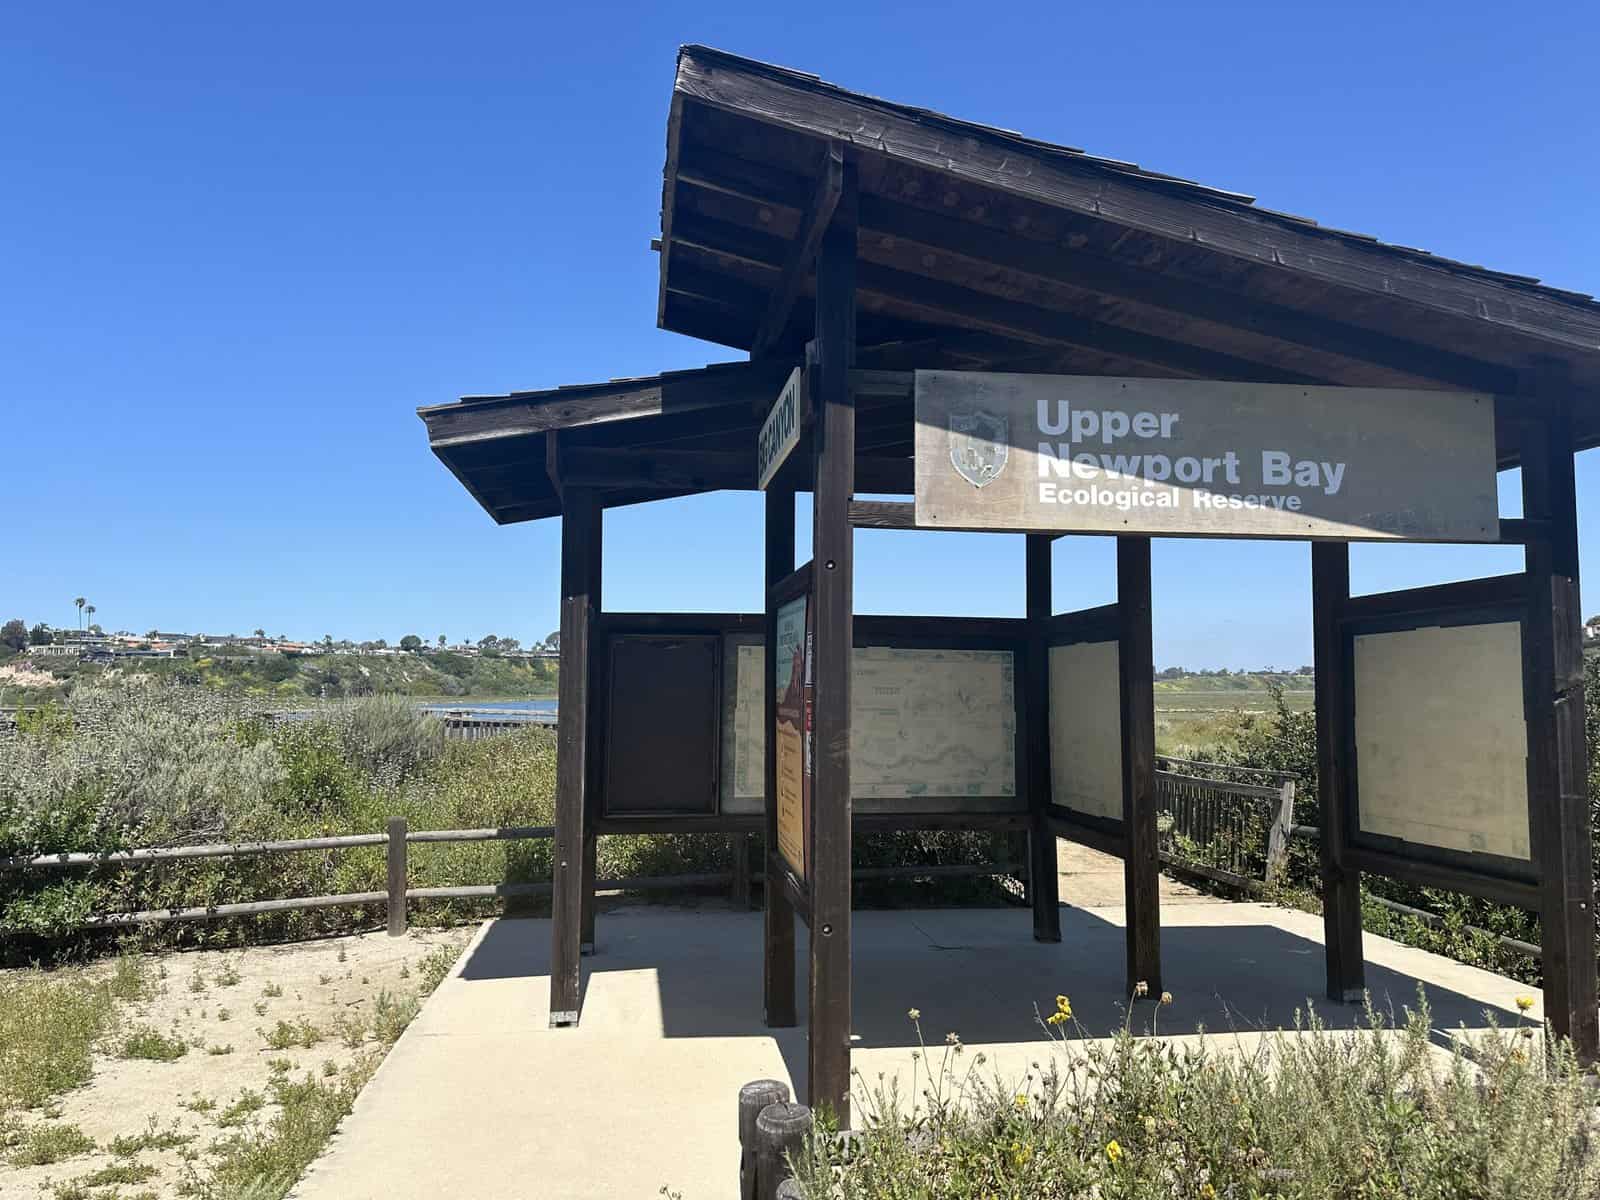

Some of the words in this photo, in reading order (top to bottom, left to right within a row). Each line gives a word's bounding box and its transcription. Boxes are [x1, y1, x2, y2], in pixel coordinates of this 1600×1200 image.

[768, 384, 795, 464] CANYON
[1036, 399, 1180, 444] Upper
[1037, 442, 1240, 488] Newport
[1261, 449, 1346, 496] Bay
[1038, 482, 1180, 510] Ecological
[1191, 488, 1303, 512] Reserve
